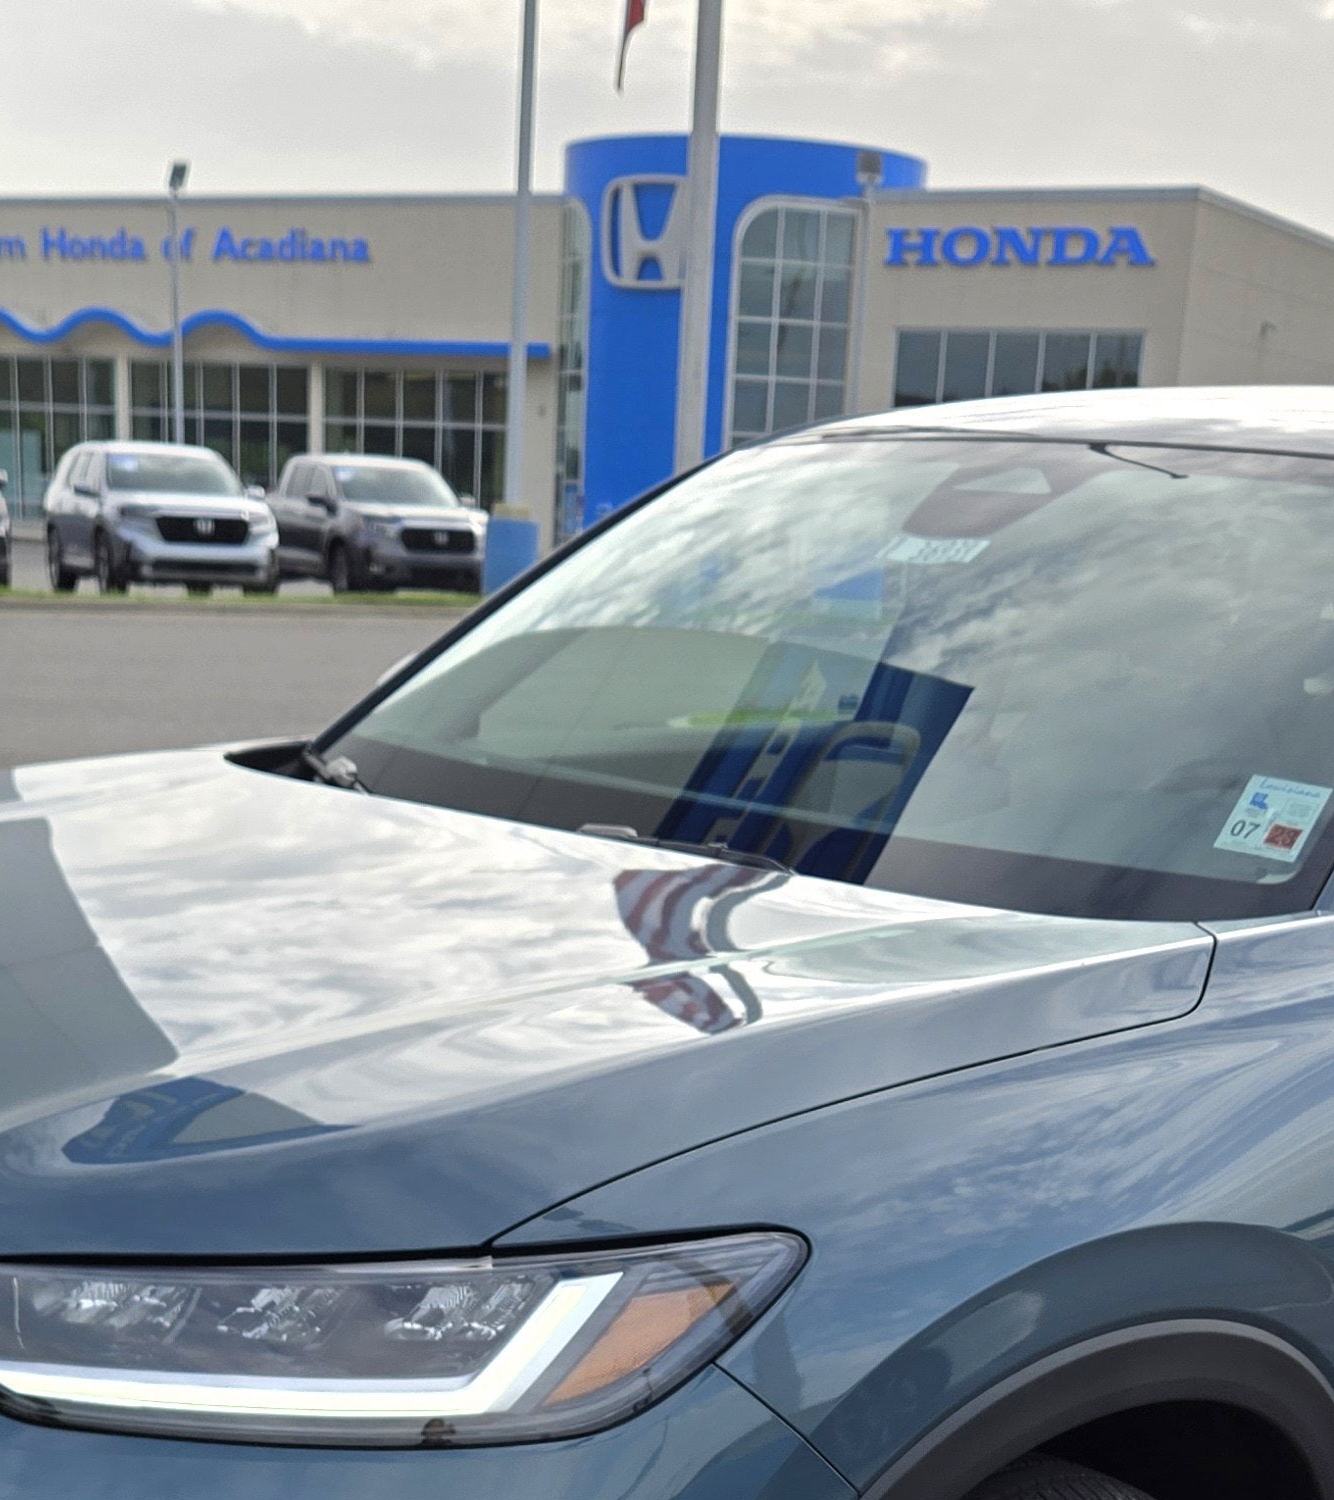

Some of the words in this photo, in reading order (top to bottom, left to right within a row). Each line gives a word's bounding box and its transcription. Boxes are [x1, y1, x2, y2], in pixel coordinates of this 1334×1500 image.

[41, 226, 146, 261] Honda
[212, 226, 370, 262] Acadiana
[884, 227, 1156, 267] HONDA
[1230, 820, 1261, 839] 07
